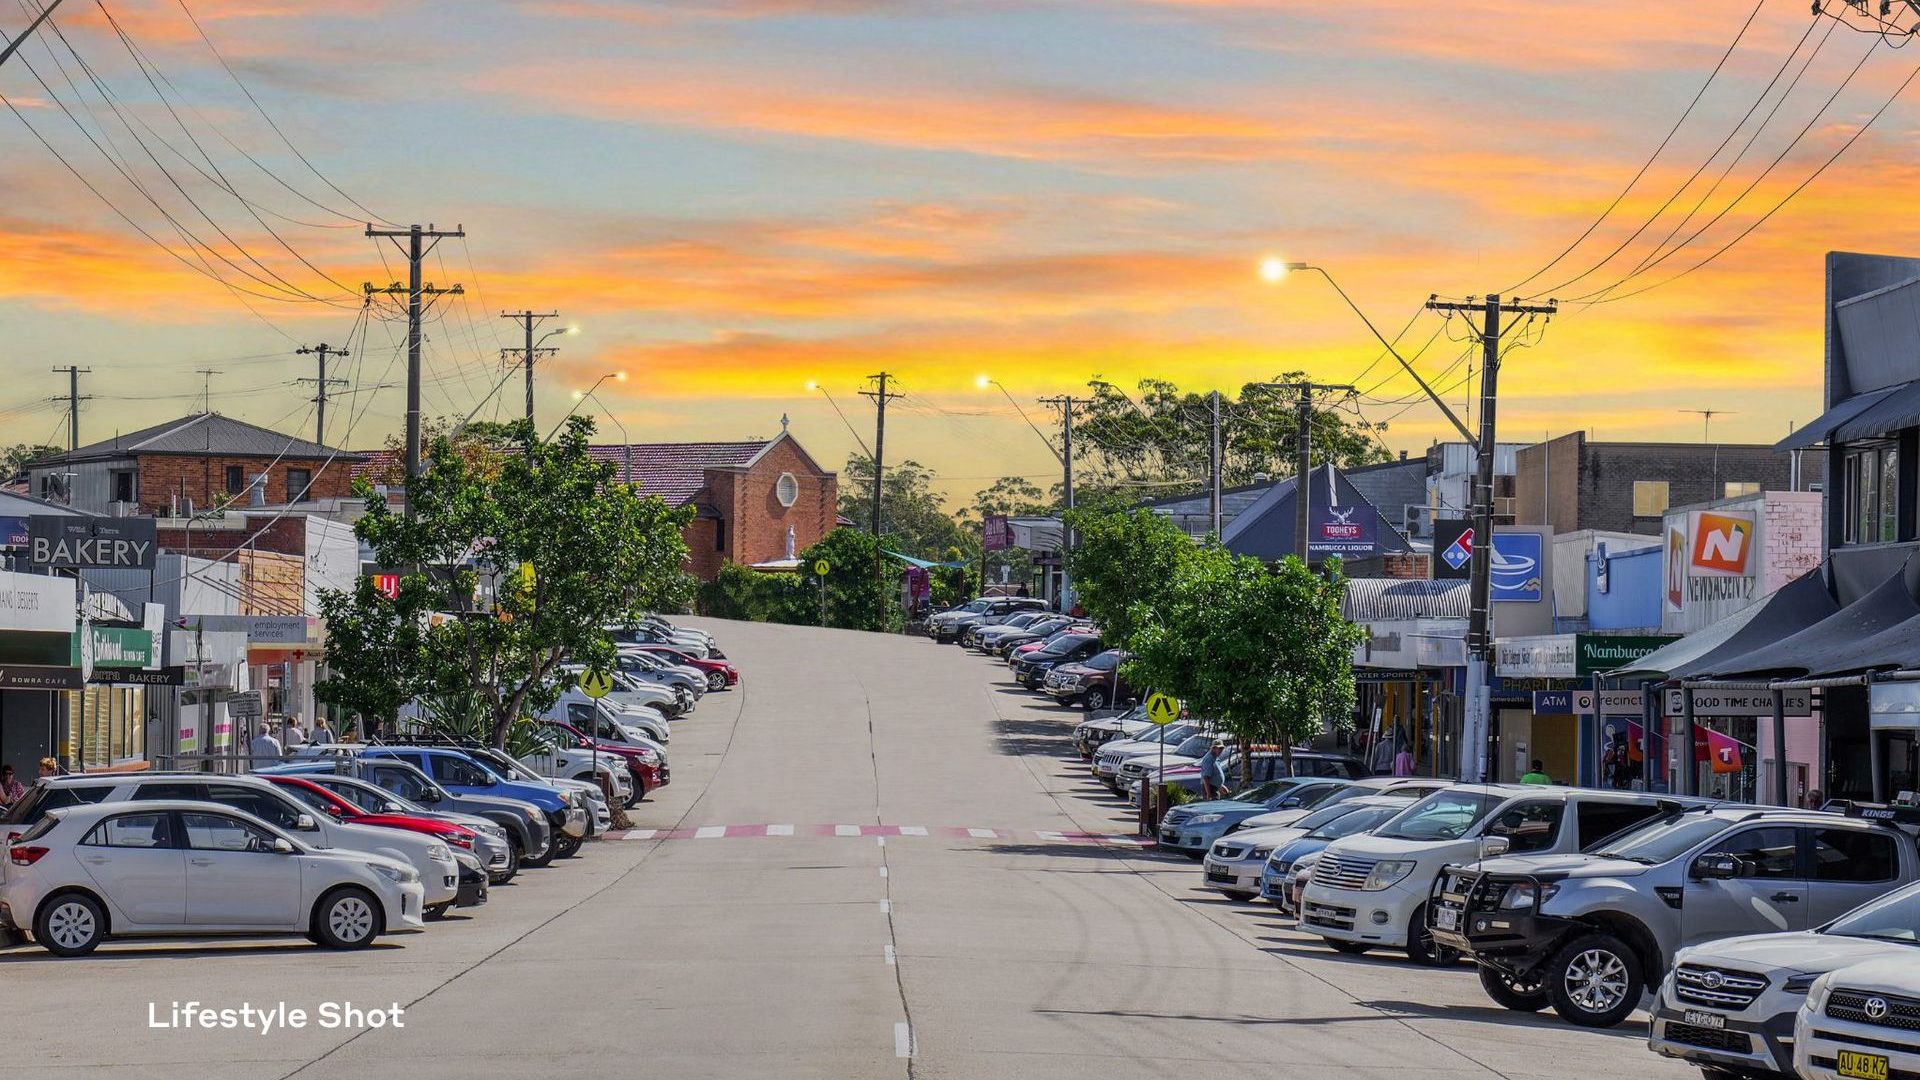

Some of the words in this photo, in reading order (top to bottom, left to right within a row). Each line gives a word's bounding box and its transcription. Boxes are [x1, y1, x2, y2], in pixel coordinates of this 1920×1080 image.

[1326, 526, 1357, 534] TOOHEYS
[1702, 524, 1744, 562] N
[33, 537, 150, 566] BAKERY
[254, 621, 300, 631] employment
[254, 630, 284, 638] services
[1584, 643, 1655, 659] Nambucca
[129, 674, 170, 683] BAKERY
[1542, 696, 1567, 706] ATM
[1592, 696, 1643, 708] recinct
[1693, 697, 1720, 708] OOD
[1723, 697, 1749, 707] TIME
[1752, 697, 1805, 708] CHAIE'S
[1861, 809, 1895, 819] KINGS
